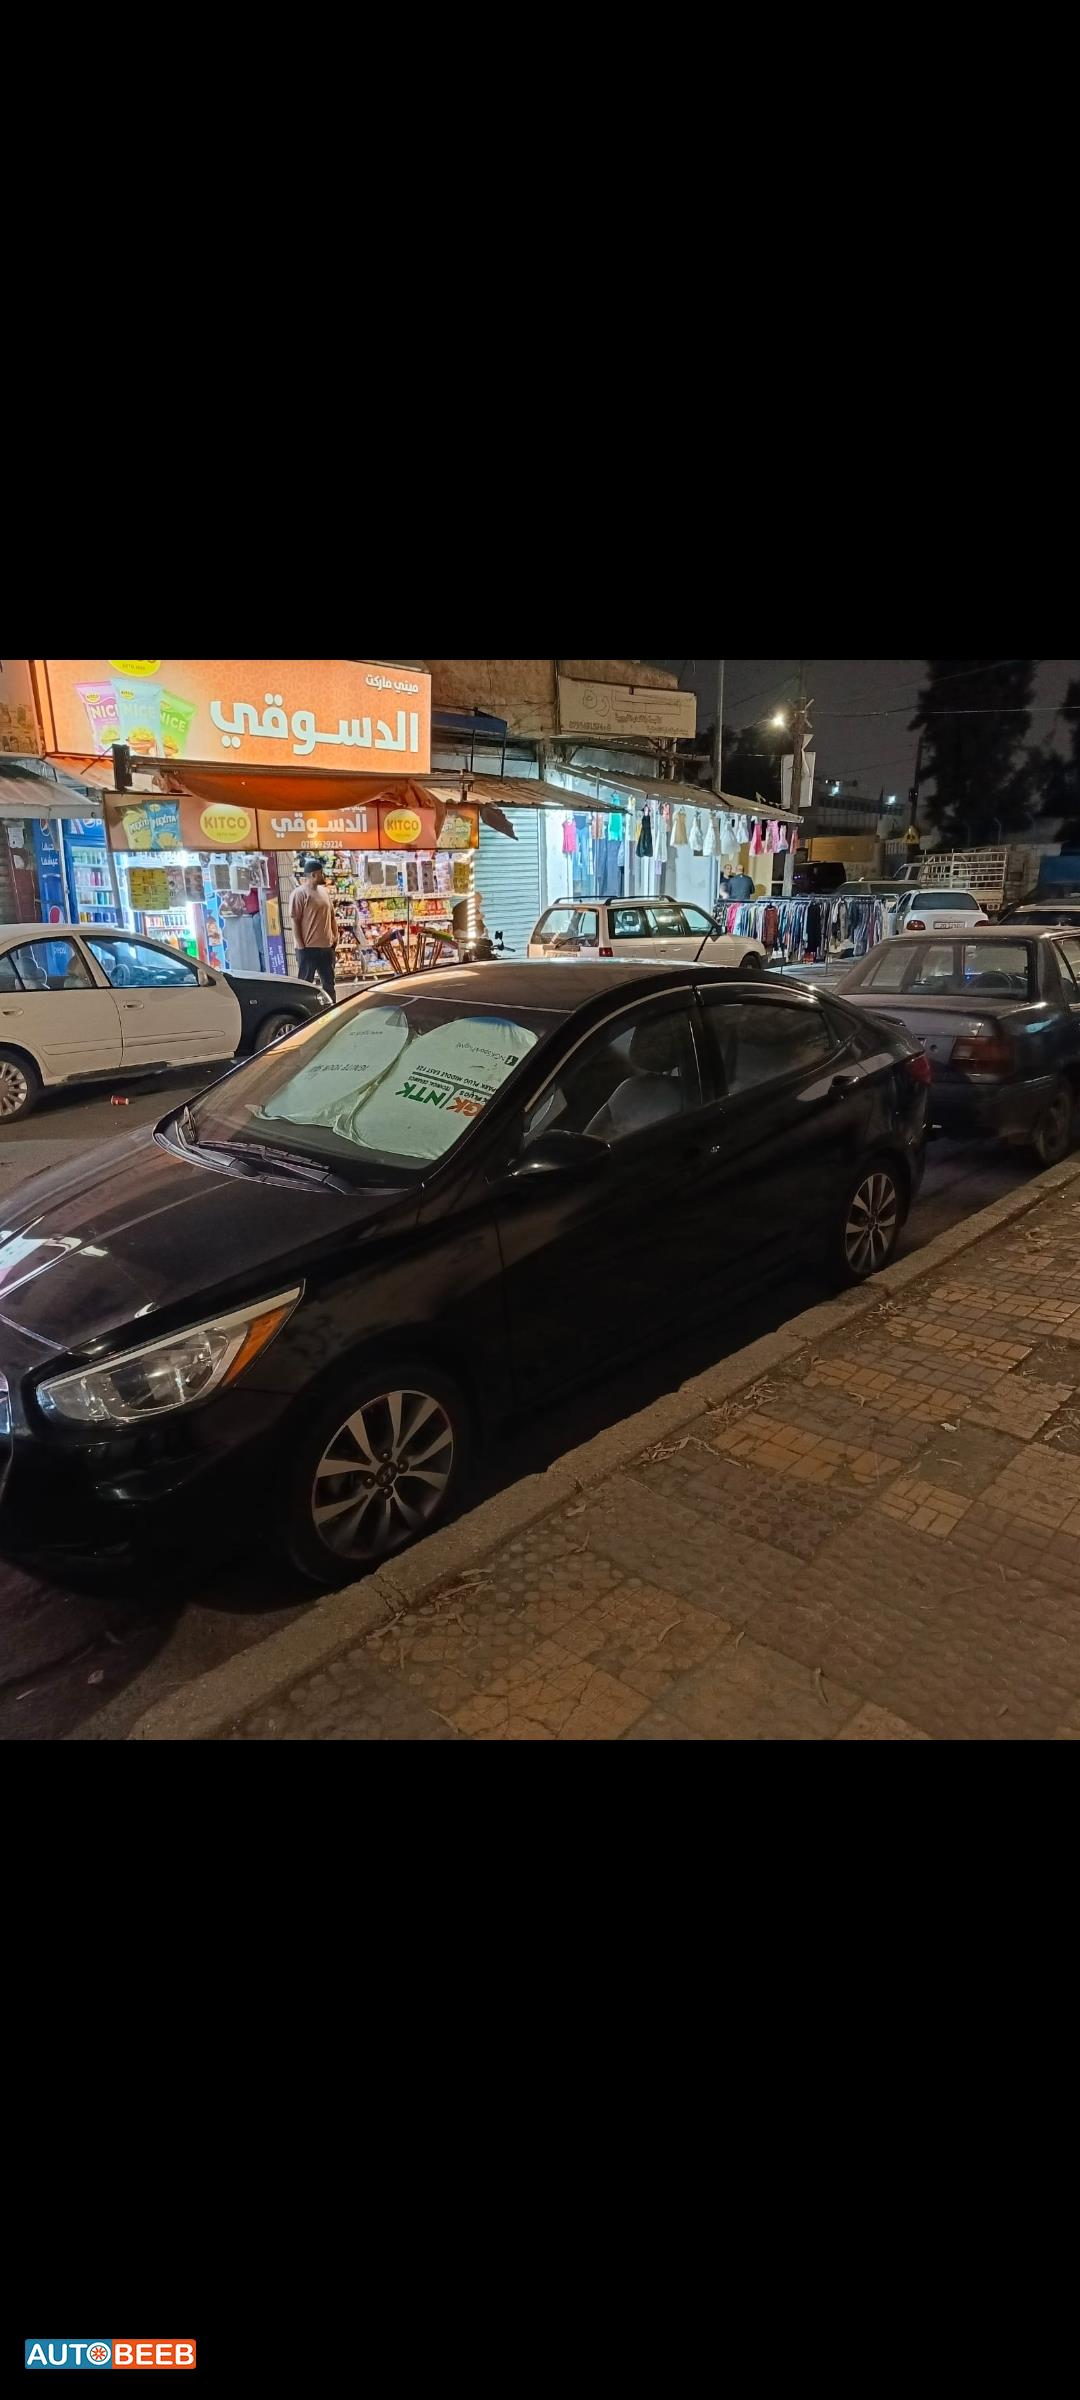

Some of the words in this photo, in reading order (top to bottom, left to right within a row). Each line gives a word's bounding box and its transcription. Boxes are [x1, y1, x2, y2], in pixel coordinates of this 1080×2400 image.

[365, 674, 392, 691] ماركت
[393, 680, 419, 694] ميني
[90, 703, 117, 719] NIC
[210, 693, 419, 755] الدسوقي
[204, 816, 248, 830] KITCO
[271, 812, 368, 839] الدسوقي
[386, 819, 419, 832] KITCO
[426, 1067, 441, 1077] EAST
[441, 1071, 463, 1083] MIDDLE
[463, 1077, 480, 1088] PLUG
[395, 1081, 447, 1107] NTK
